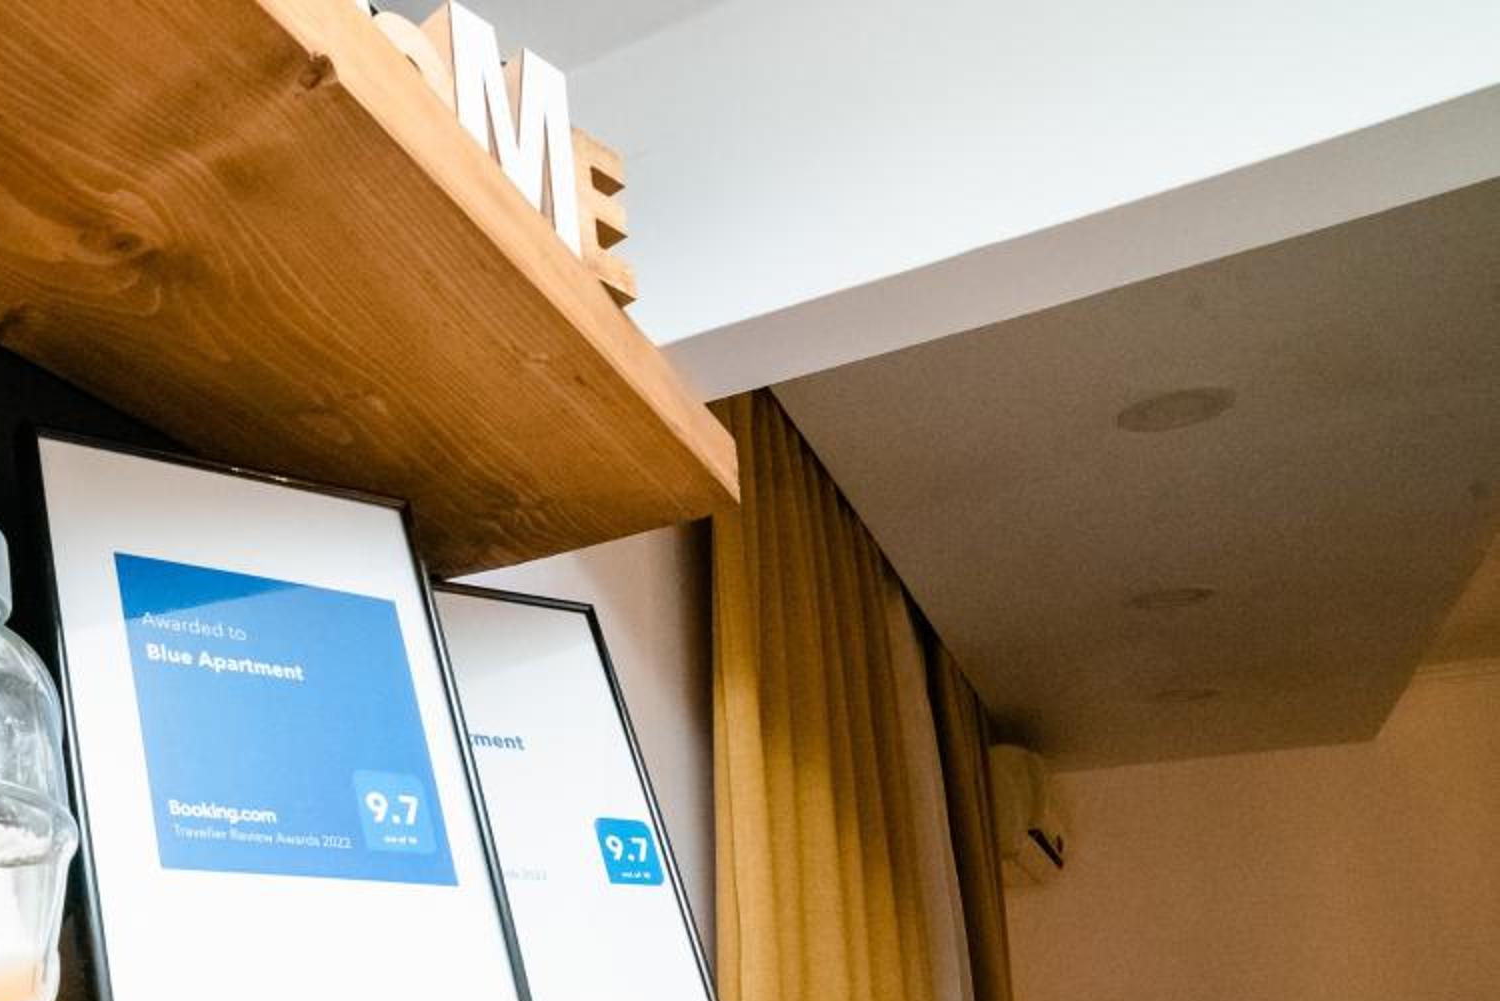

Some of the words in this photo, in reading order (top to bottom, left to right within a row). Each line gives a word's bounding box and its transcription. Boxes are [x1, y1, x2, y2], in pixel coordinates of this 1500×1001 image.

[142, 612, 223, 638] Awarded
[227, 626, 247, 641] to
[145, 643, 193, 666] Blue
[198, 650, 305, 682] Apartment
[167, 799, 278, 825] Booking.com
[364, 791, 419, 826] 9.7
[605, 834, 648, 863] 9.7
